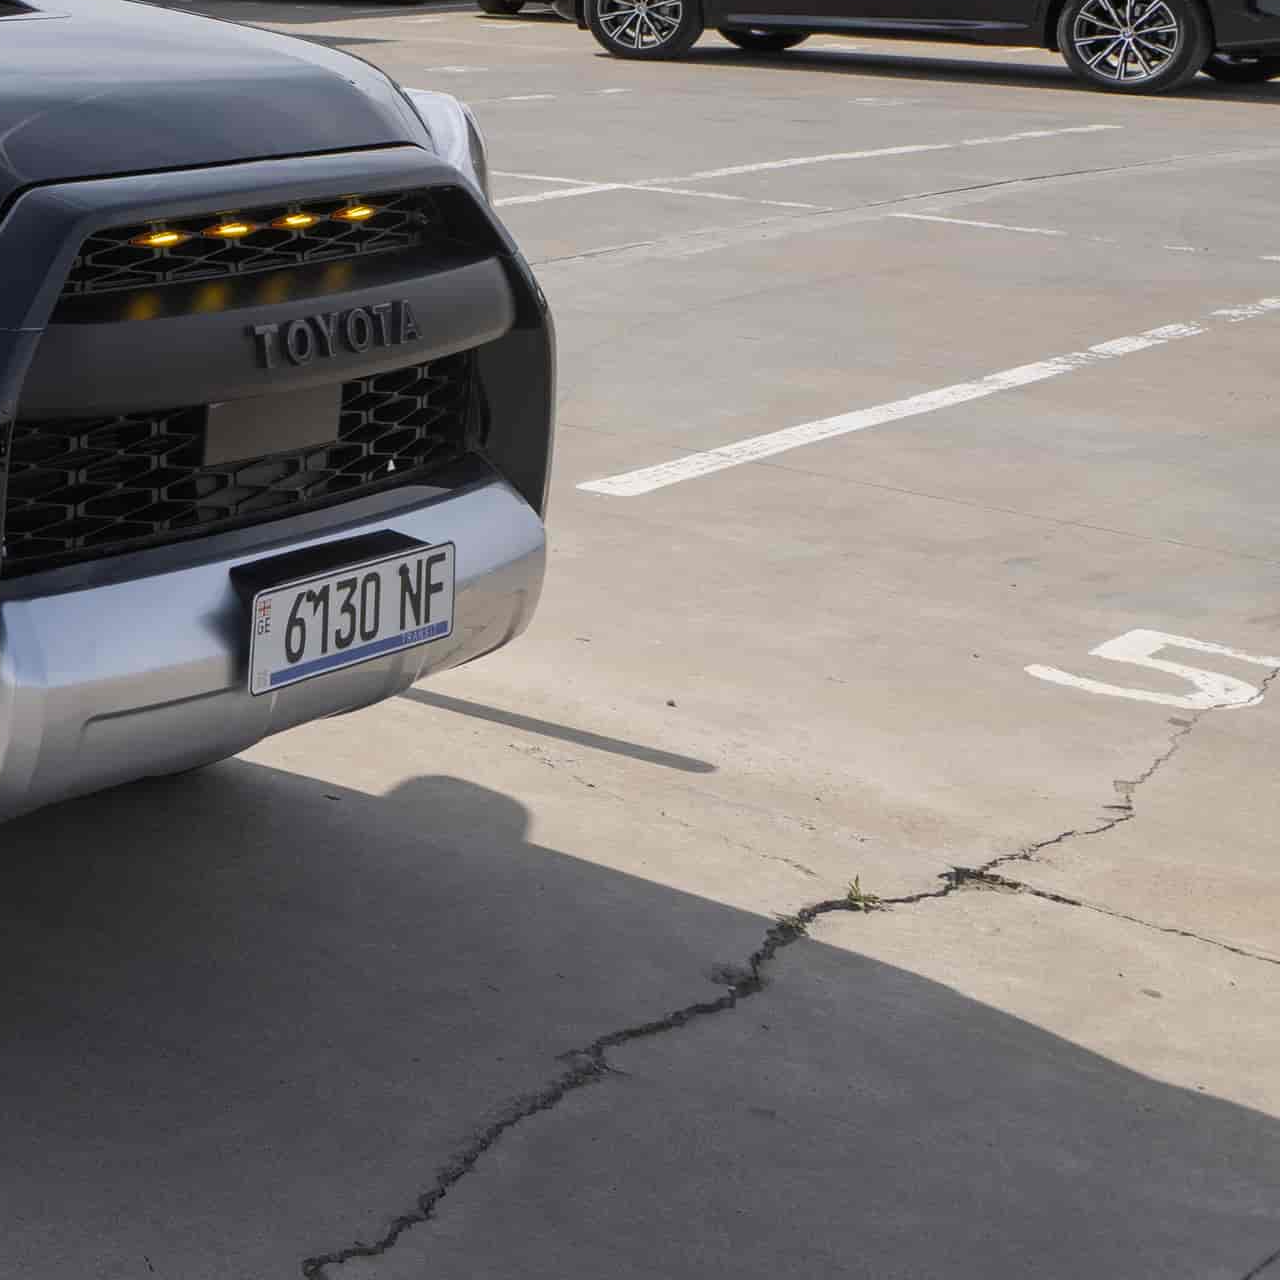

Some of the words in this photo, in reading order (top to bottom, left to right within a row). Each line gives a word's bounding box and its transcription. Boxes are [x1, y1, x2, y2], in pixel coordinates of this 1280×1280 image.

[248, 299, 423, 369] TOYOTA
[257, 617, 271, 636] GE
[284, 571, 381, 663] 6130
[398, 552, 446, 630] NF
[1023, 628, 1280, 709] 5
